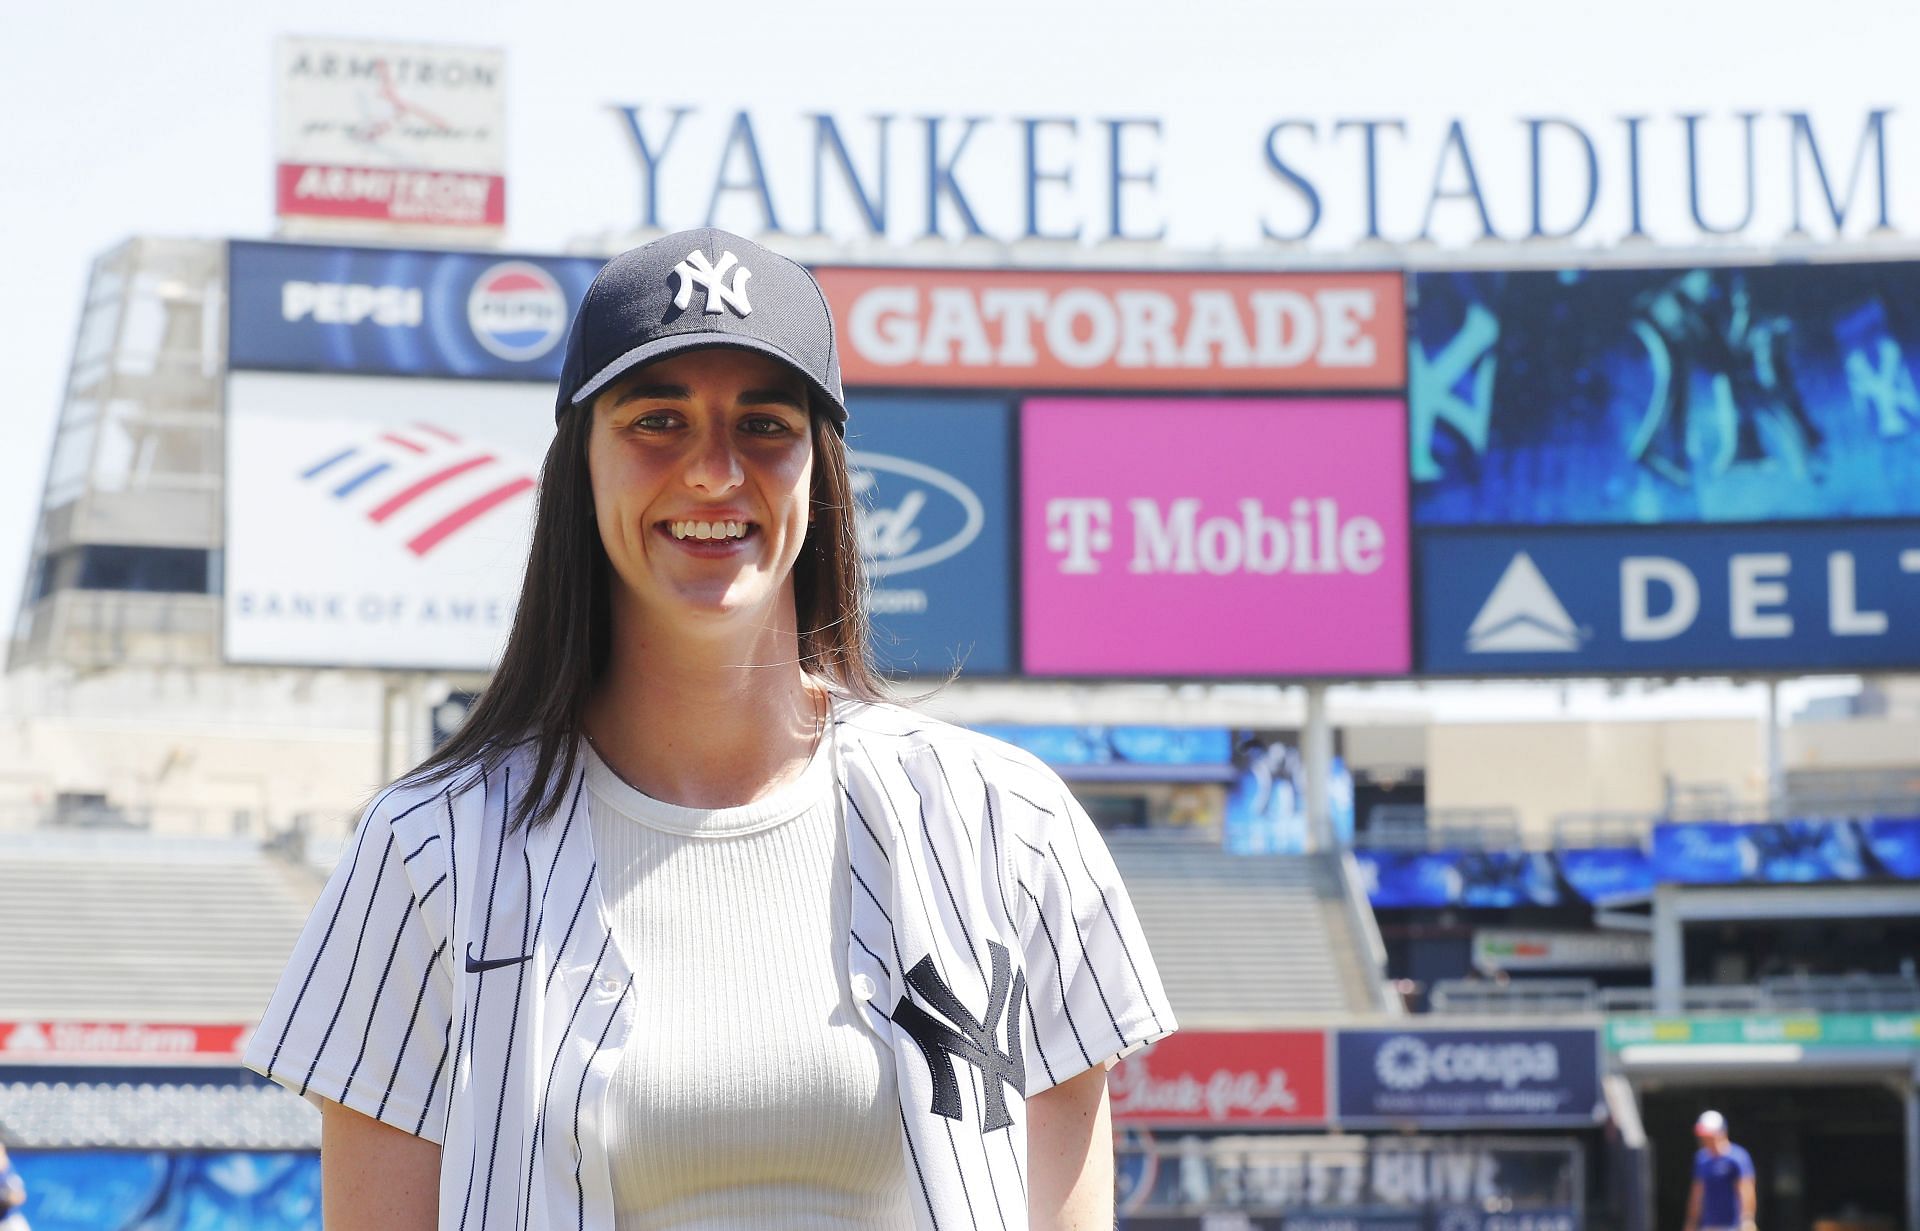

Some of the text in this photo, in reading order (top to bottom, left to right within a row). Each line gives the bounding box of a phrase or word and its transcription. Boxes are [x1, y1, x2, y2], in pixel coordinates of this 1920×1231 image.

[289, 53, 497, 88] ARMTRON
[606, 104, 1896, 243] YANKEE STADIUM
[281, 281, 424, 327] PEPSI
[673, 249, 753, 317] NY
[847, 286, 1377, 368] GATORADE
[1128, 497, 1386, 575] Mobile
[236, 593, 505, 624] BANK OF AME
[890, 938, 1027, 1134] NY
[1431, 1041, 1558, 1090] coupa
